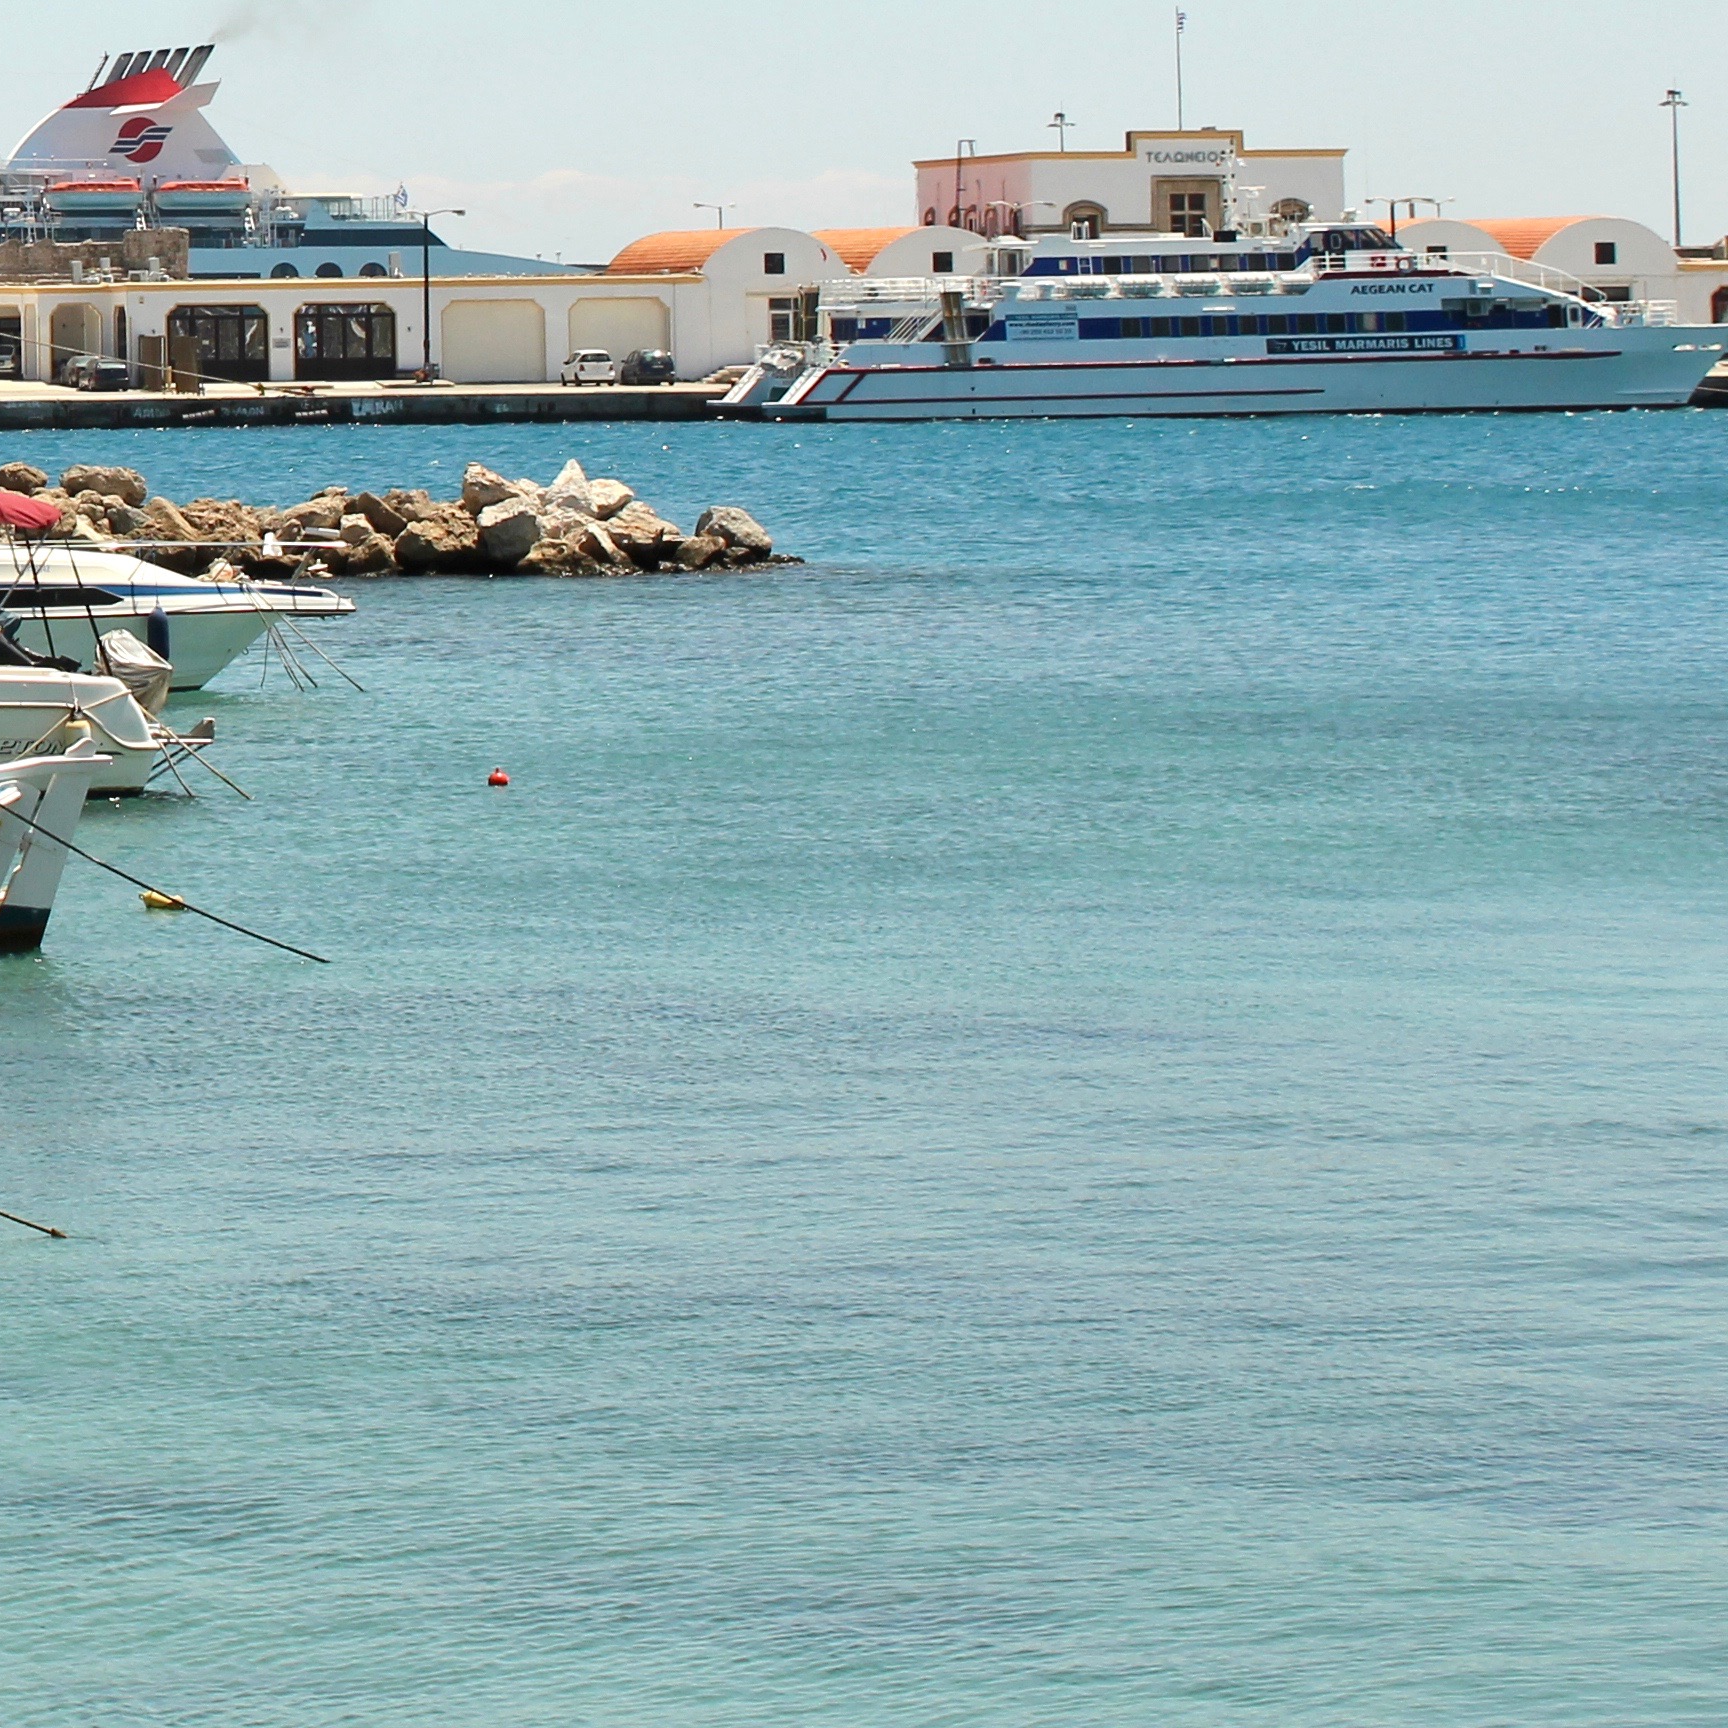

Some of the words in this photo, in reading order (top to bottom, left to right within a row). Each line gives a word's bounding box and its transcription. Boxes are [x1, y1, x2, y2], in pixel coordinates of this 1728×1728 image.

[1351, 283, 1405, 295] AEGEAN
[1408, 282, 1434, 293] CAT
[1292, 340, 1330, 351] YESIL
[1335, 338, 1408, 350] MARMARIS
[1414, 337, 1453, 349] LINES
